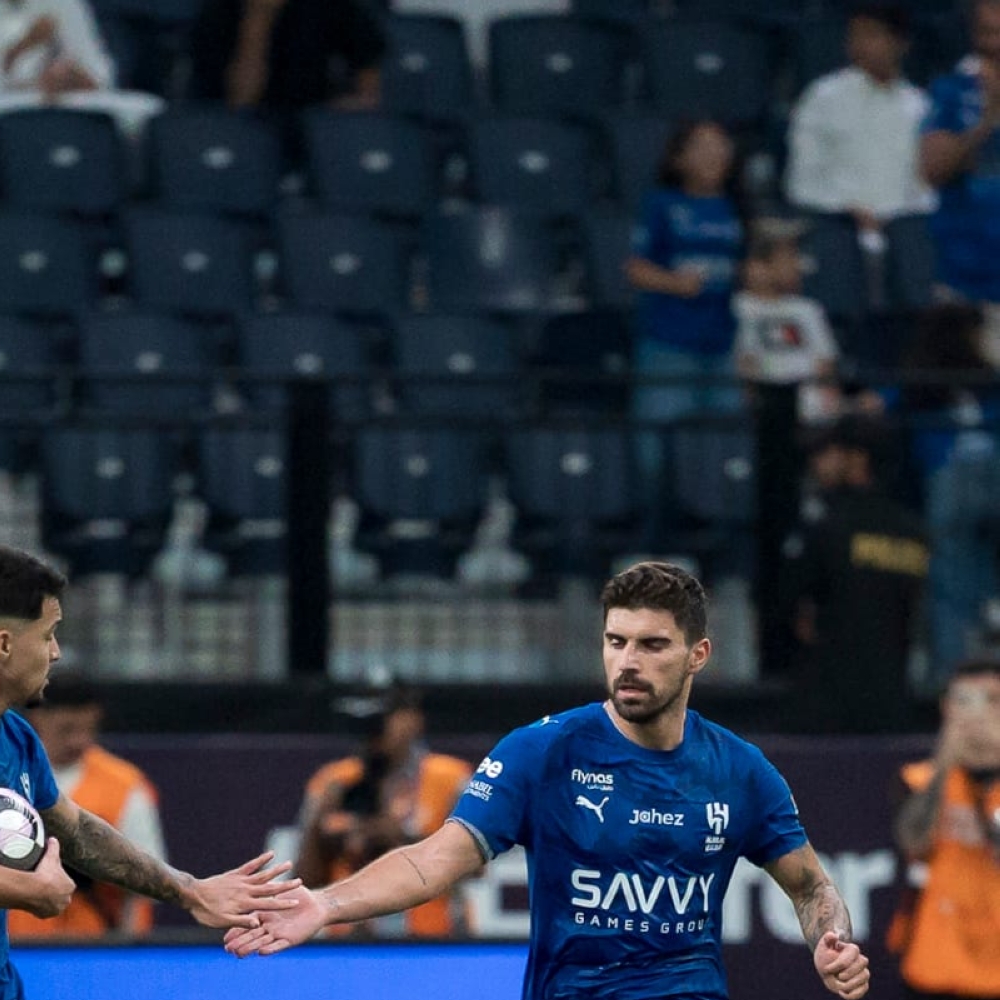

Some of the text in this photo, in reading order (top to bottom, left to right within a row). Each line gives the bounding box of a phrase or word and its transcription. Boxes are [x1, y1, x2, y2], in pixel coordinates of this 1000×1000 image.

[571, 768, 614, 785] flynas
[570, 868, 716, 915] SAVVY
[574, 911, 650, 933] GAMES
